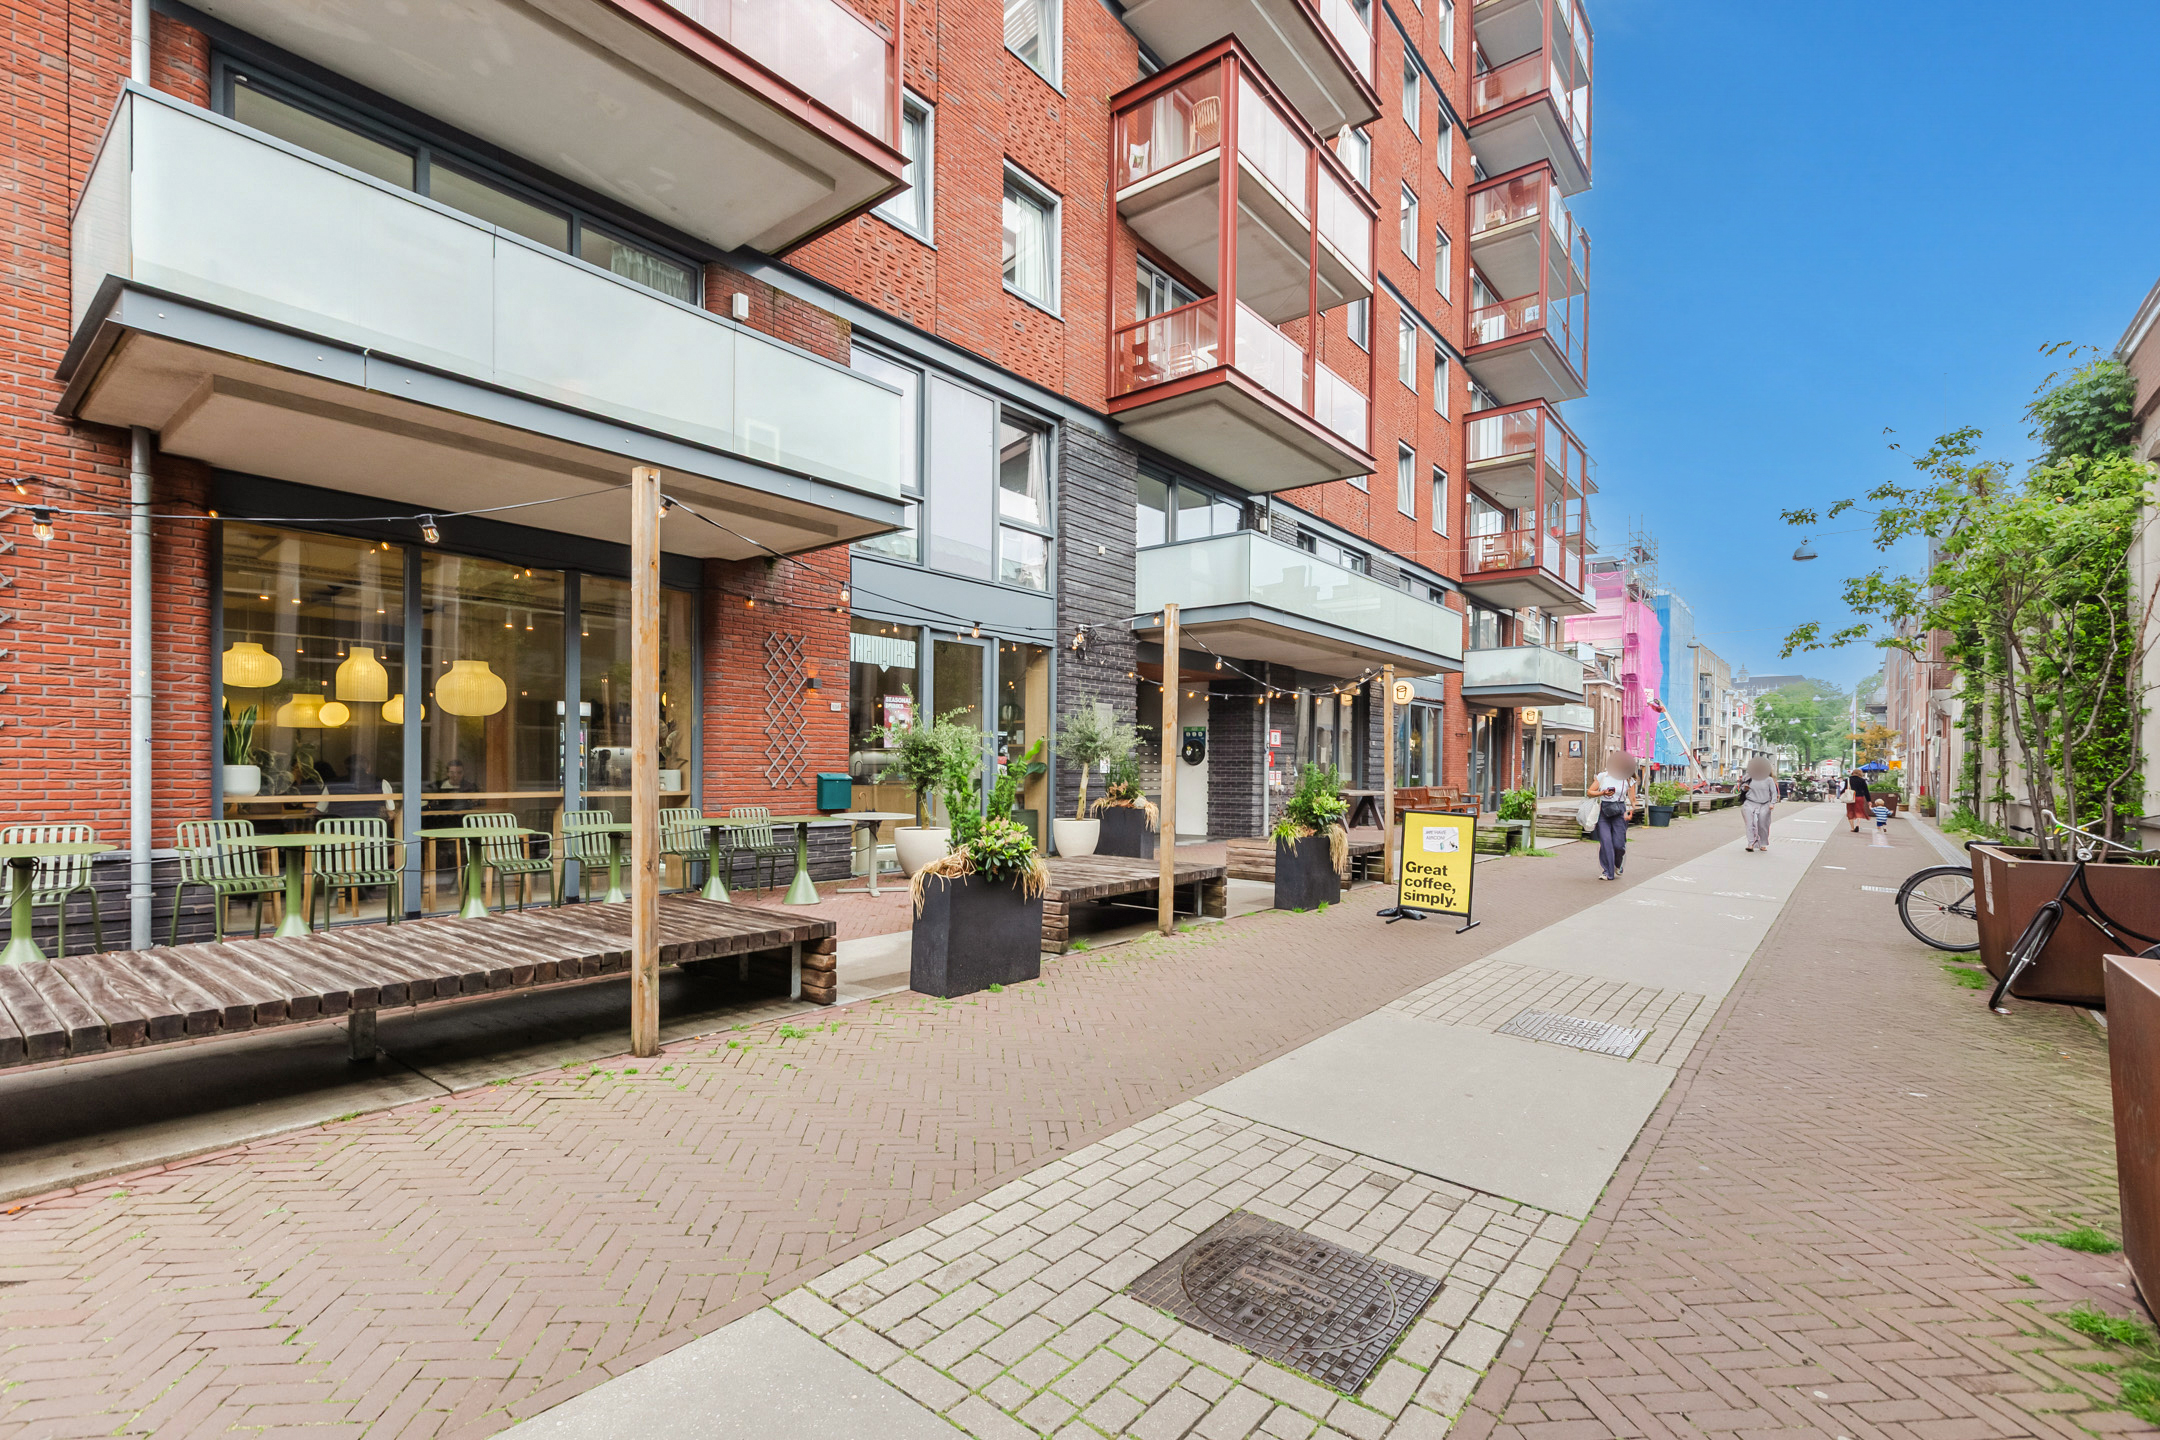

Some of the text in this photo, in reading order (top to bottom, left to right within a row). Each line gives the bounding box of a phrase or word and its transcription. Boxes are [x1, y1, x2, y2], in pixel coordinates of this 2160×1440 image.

[1405, 861, 1448, 876] Great
[1404, 877, 1456, 894] coffee,
[1404, 890, 1456, 907] simply.
[1226, 1280, 1319, 1321] AMSTERDAM
